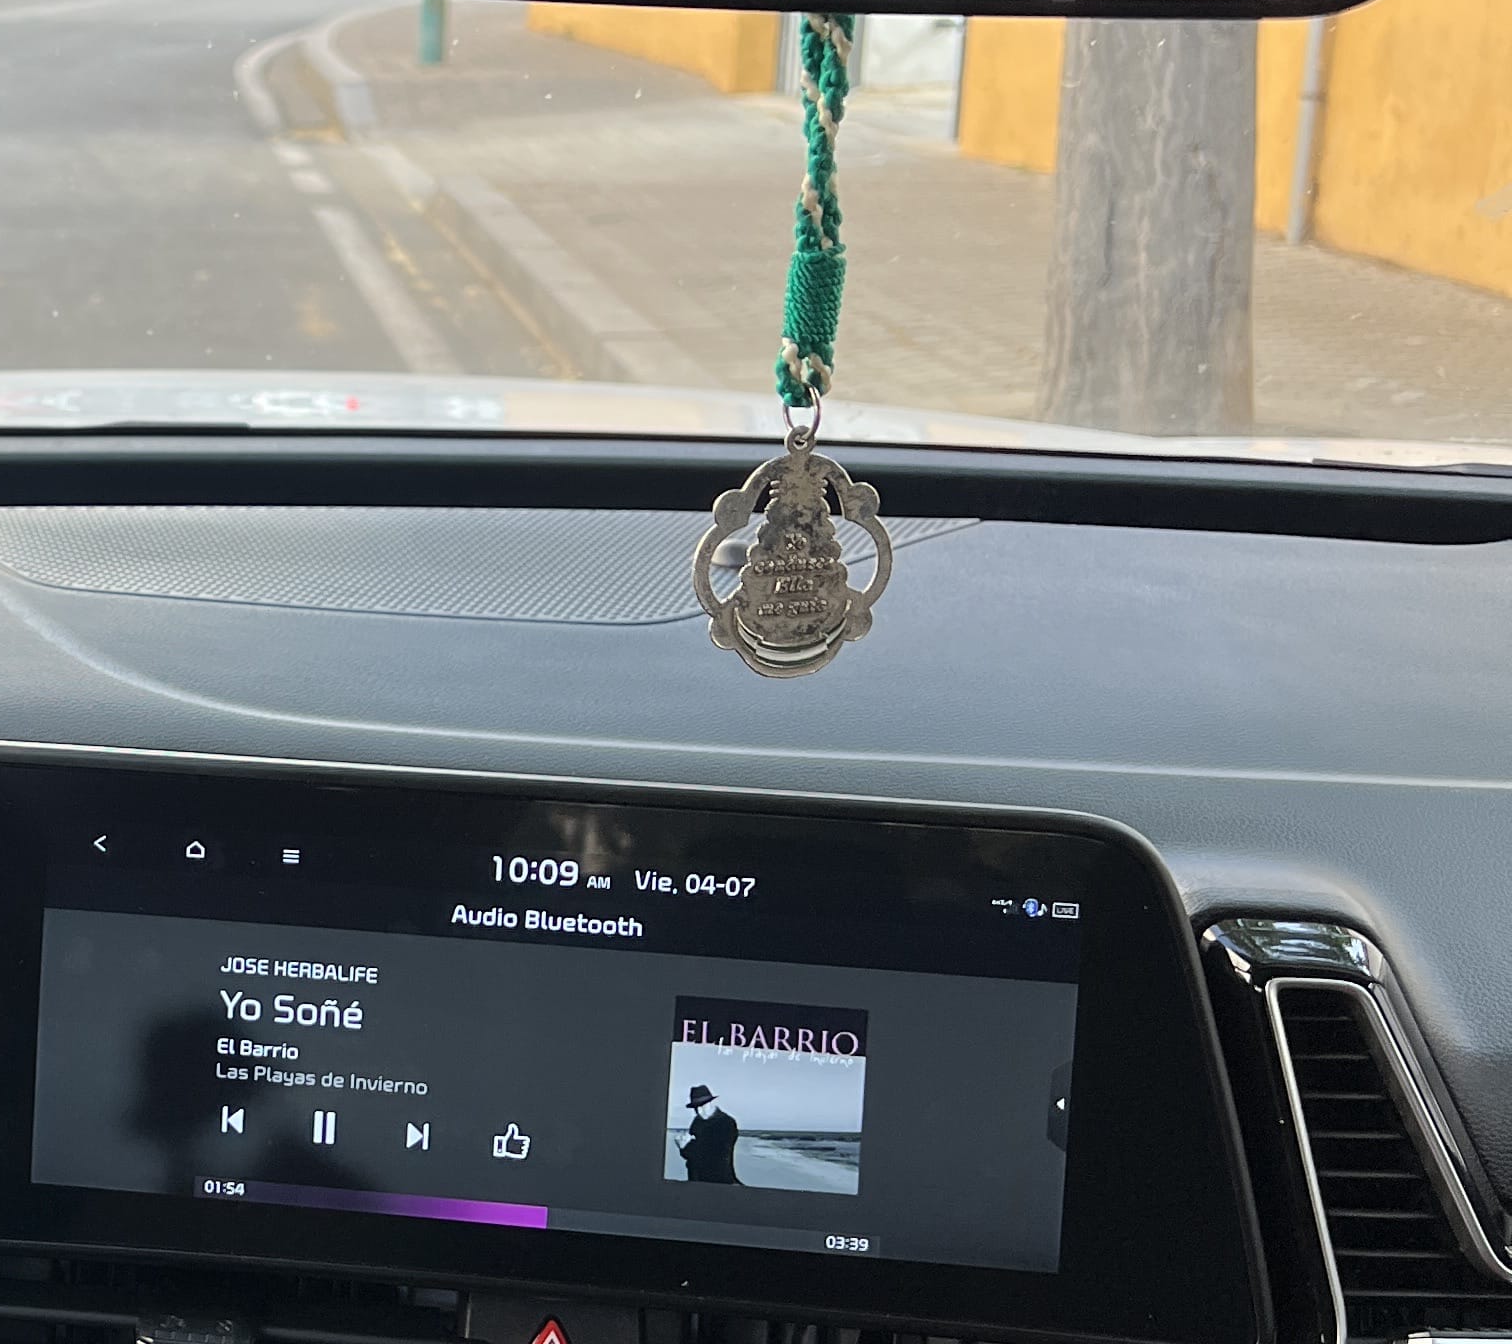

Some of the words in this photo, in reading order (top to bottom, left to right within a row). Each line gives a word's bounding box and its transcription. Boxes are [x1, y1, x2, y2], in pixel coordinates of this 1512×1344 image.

[492, 855, 579, 887] 10:09
[587, 874, 611, 890] AM
[634, 869, 678, 895] Vie.
[685, 873, 756, 897] 04-07
[451, 905, 518, 928] Audio
[524, 910, 643, 937] Bluetooth
[220, 957, 269, 976] JOSE
[274, 960, 379, 984] HERBALIFE
[219, 989, 262, 1022] Yo
[273, 994, 364, 1030] Soñé
[217, 1037, 235, 1055] El
[240, 1039, 299, 1060] Barrio
[682, 1019, 718, 1046] EL
[729, 1022, 860, 1057] BARRIO
[216, 1063, 249, 1081] Las
[254, 1065, 316, 1087] Playas
[321, 1072, 345, 1088] de
[350, 1073, 428, 1096] Invierno
[204, 1179, 245, 1196] 01:54
[825, 1235, 869, 1252] 03:39
